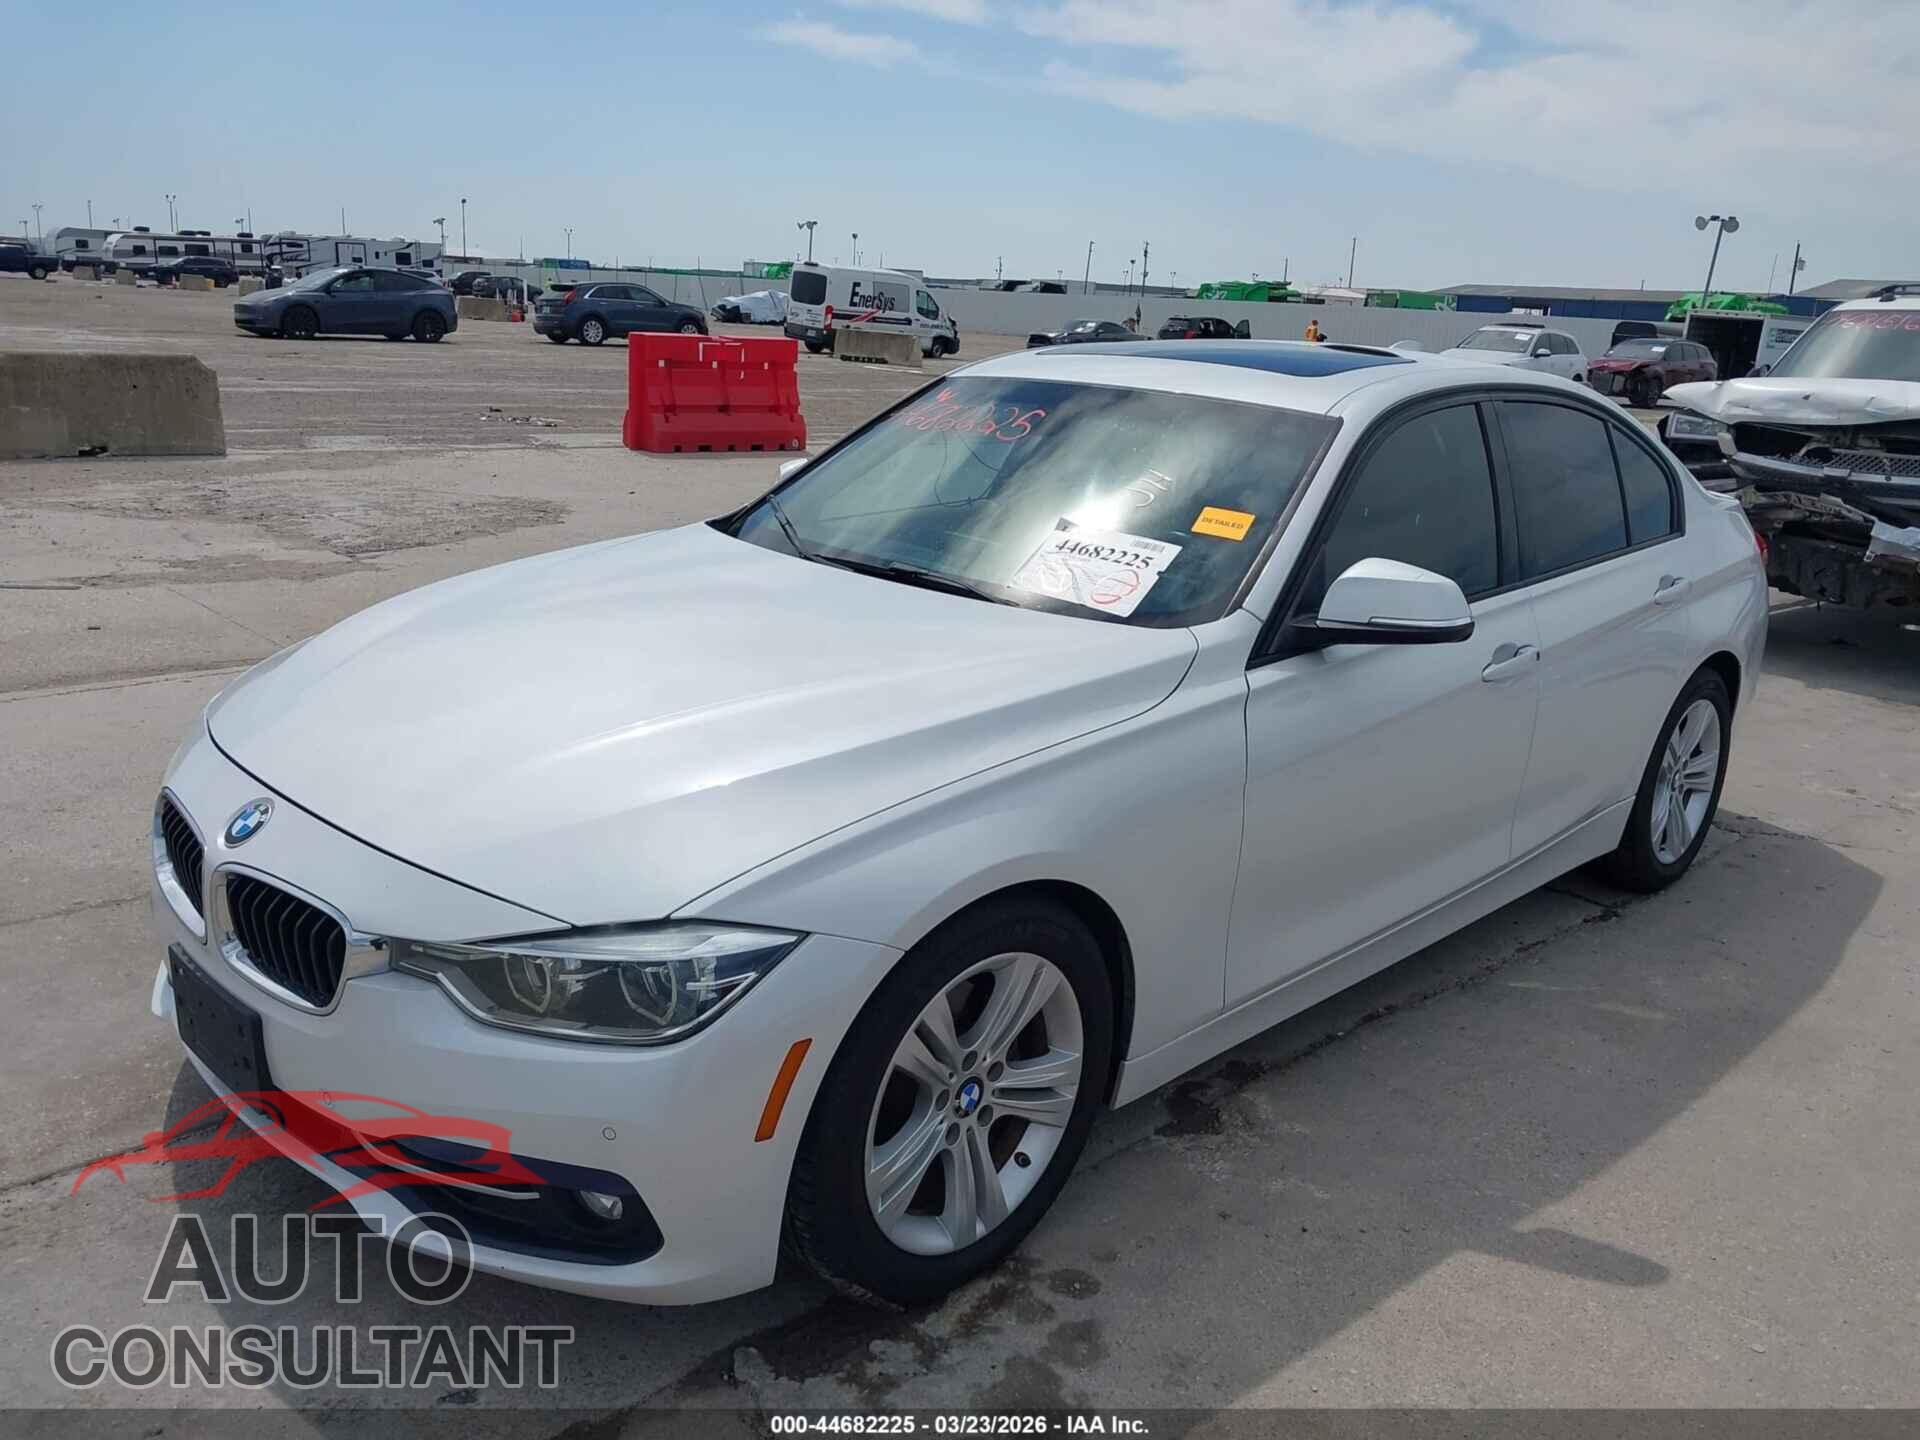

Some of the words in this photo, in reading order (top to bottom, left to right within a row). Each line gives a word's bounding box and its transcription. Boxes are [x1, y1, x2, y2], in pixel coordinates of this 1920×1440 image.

[850, 282, 895, 313] EnerSys
[1202, 516, 1244, 530] DETAILED
[1055, 538, 1155, 569] 44682225
